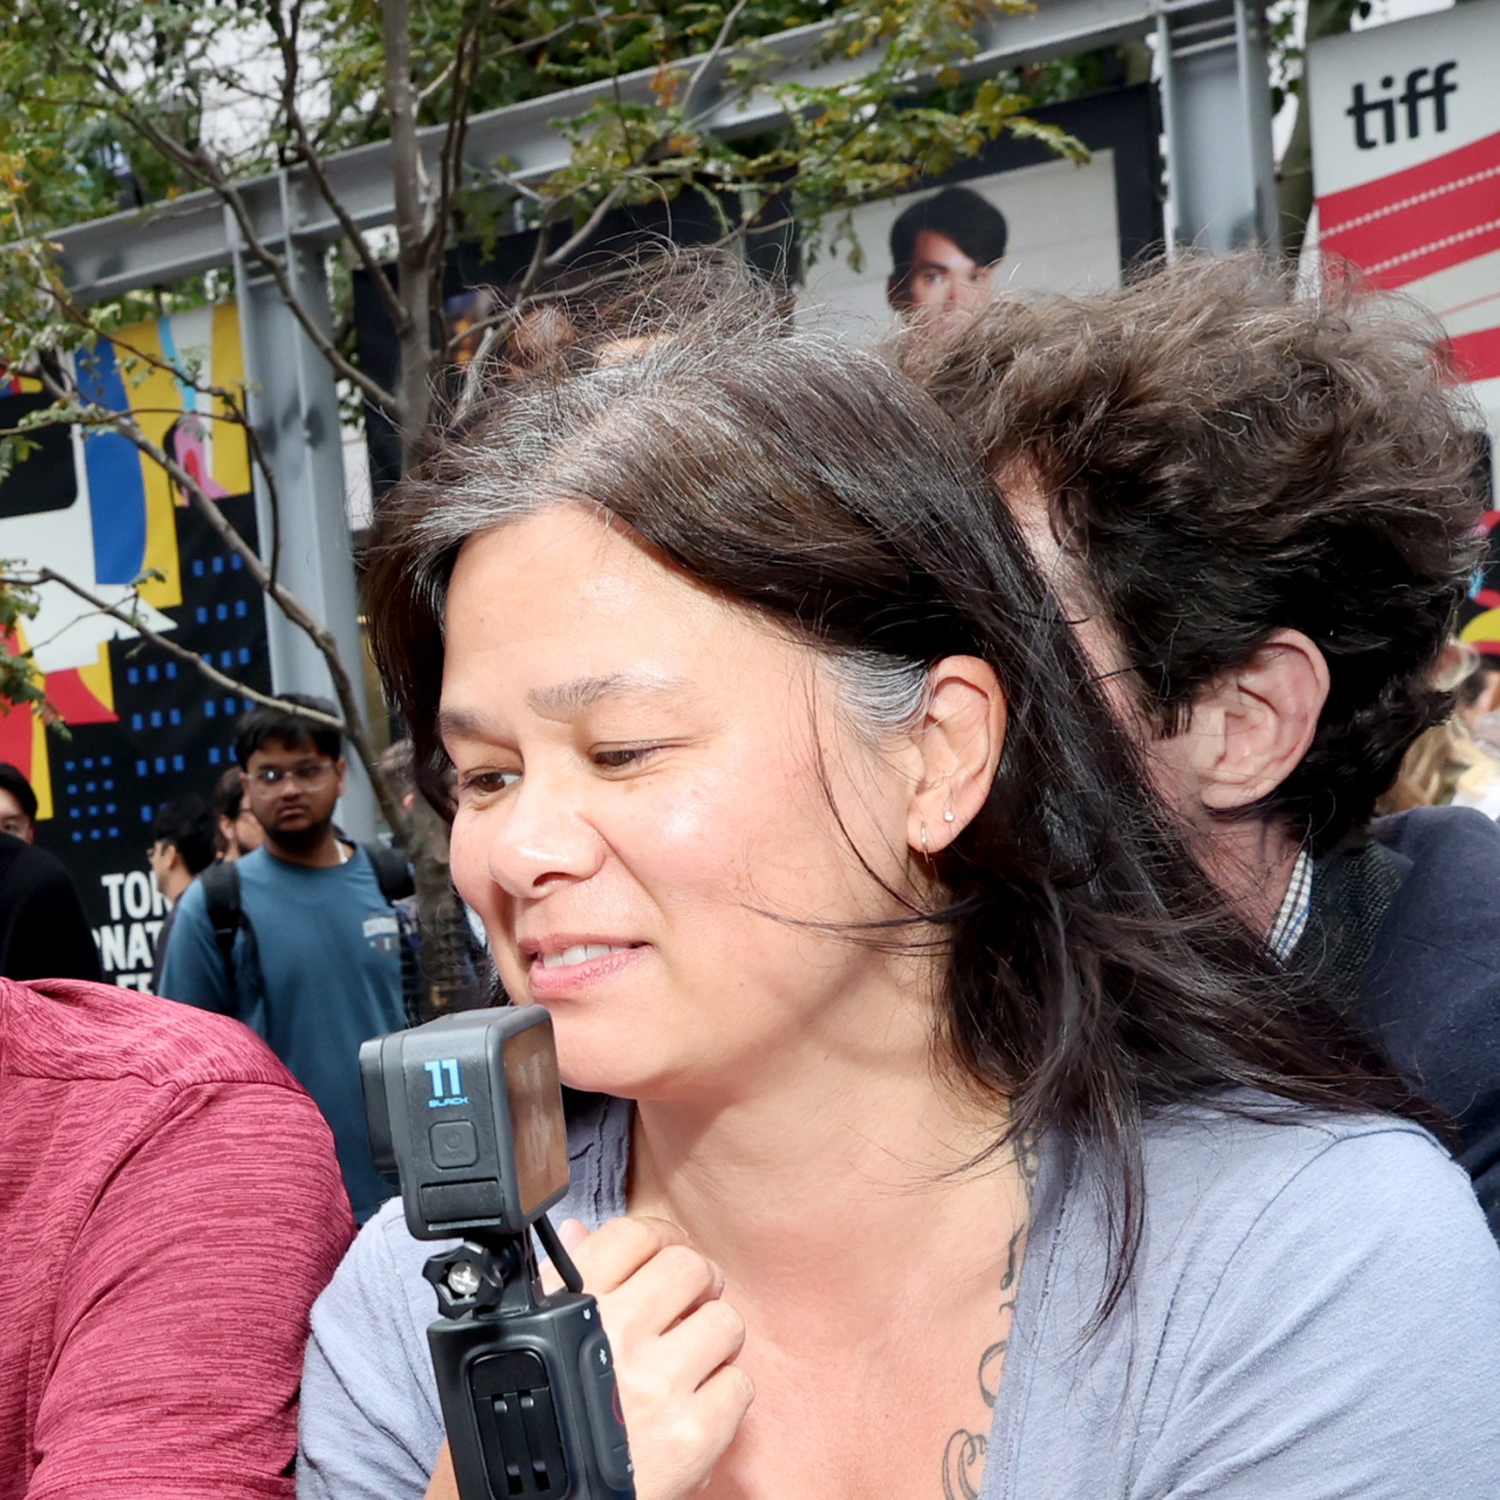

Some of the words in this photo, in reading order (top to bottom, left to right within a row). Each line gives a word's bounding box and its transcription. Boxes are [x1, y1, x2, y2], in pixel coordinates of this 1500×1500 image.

[1346, 61, 1457, 150] tiff
[92, 920, 164, 972] NAT
[424, 1058, 461, 1098] 11
[428, 1097, 469, 1108] BLACK
